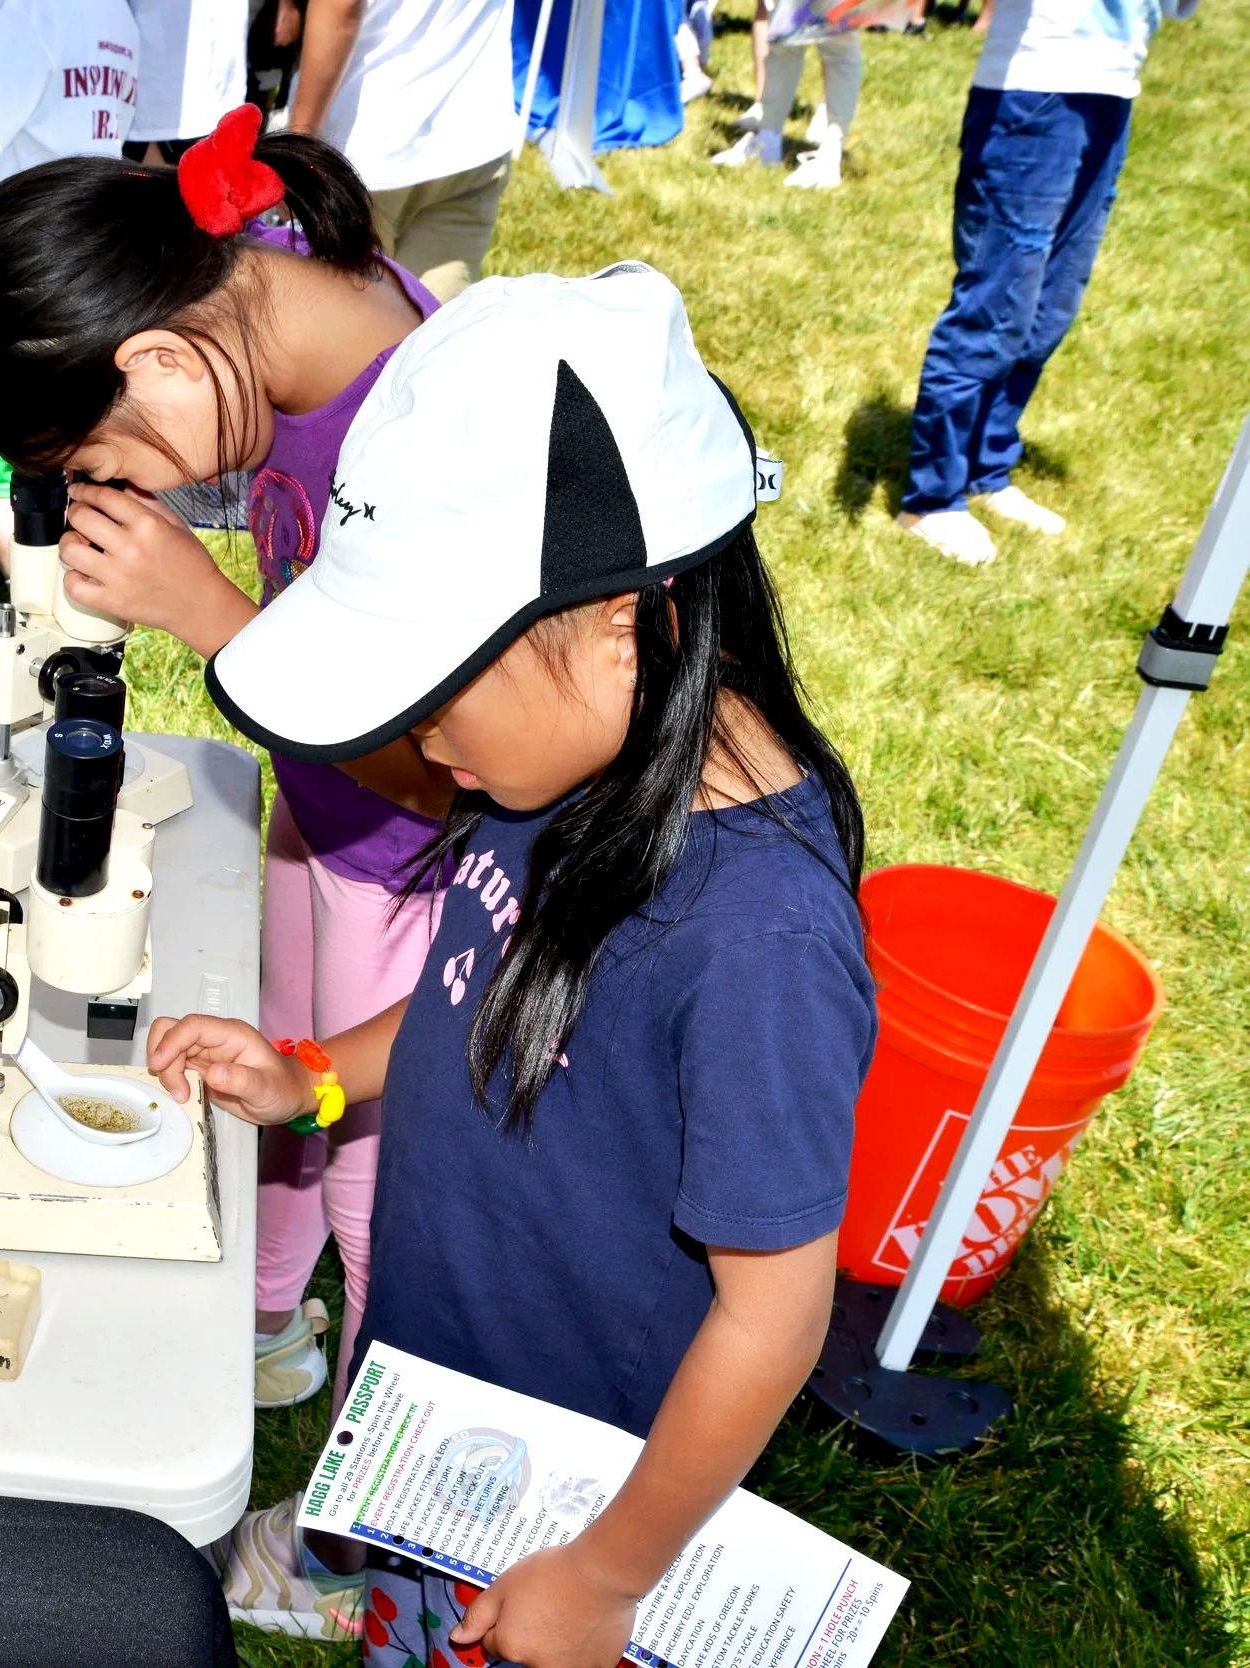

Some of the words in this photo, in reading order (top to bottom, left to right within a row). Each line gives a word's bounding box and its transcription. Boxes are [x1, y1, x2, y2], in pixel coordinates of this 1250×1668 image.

[453, 850, 521, 932] atur
[382, 1372, 400, 1398] Wheel
[376, 1399, 388, 1413] the
[304, 1481, 331, 1516] HAGG
[318, 1449, 345, 1480] LAKE
[345, 1360, 386, 1423] PASSPORT
[345, 1489, 357, 1502] for
[351, 1458, 372, 1489] PRIZES
[366, 1431, 385, 1458] before
[381, 1414, 393, 1431] you
[387, 1392, 404, 1414] leave
[348, 1436, 370, 1470] Stations
[343, 1470, 354, 1482] 29
[355, 1496, 373, 1522] EVENT
[368, 1439, 400, 1496] REGISTRATION
[395, 1412, 413, 1439] CHECK
[407, 1402, 418, 1413] IN
[369, 1501, 386, 1527] EVENT
[381, 1444, 414, 1501] REGISTRATION
[409, 1417, 427, 1444] CHECK
[422, 1399, 436, 1418] OUT
[472, 1461, 486, 1480] OUT
[339, 1481, 349, 1493] all
[393, 1453, 426, 1509] REGISTRATION
[432, 1464, 453, 1497] RETURN
[460, 1479, 478, 1507] CHECK
[473, 1475, 497, 1512] RETURNS
[327, 1503, 339, 1517] Go
[334, 1493, 344, 1503] to
[396, 1519, 410, 1537] LIFE
[405, 1491, 423, 1521] JACKET
[418, 1461, 438, 1492] FITTING
[419, 1496, 437, 1526] JACKET
[425, 1515, 445, 1547] ANGLER
[439, 1469, 467, 1515] EDUCATION
[488, 1484, 509, 1516] FISHING
[383, 1508, 398, 1531] BOAT
[410, 1524, 424, 1541] LIFE
[450, 1508, 466, 1527] REEL
[464, 1513, 480, 1532] REEL
[490, 1503, 516, 1546] BOARDING
[524, 1506, 547, 1544] ECOLOGY
[380, 1531, 389, 1539] 2
[407, 1541, 416, 1549] 3
[438, 1533, 452, 1552] ROD
[451, 1538, 466, 1558] ROD
[466, 1515, 494, 1562] SHORE-LINE
[493, 1555, 508, 1576] FISH
[503, 1516, 527, 1555] CLEANING
[435, 1552, 444, 1560] 5
[449, 1557, 458, 1566] 5
[462, 1563, 472, 1571] 6
[479, 1545, 495, 1569] BOAT
[476, 1569, 485, 1577] 7
[647, 1638, 659, 1652] BB
[654, 1618, 668, 1639] GUN
[663, 1600, 678, 1620] EDU.
[673, 1543, 706, 1600] EXPLORATION
[662, 1619, 685, 1659] ARCHERY
[690, 1543, 724, 1601] EXPLORATION
[823, 1611, 842, 1638] HOLE
[835, 1578, 858, 1613] PUNCH
[845, 1626, 858, 1643] 20+
[858, 1605, 870, 1617] 10
[864, 1581, 883, 1607] Spins
[626, 1643, 639, 1656] 18
[633, 1608, 655, 1643] GASTON
[650, 1589, 665, 1609] FIRE
[659, 1583, 668, 1591] &
[701, 1632, 717, 1653] KIDS
[711, 1619, 722, 1633] OF
[717, 1584, 740, 1620] OREGON
[722, 1615, 744, 1646] TACKLE
[738, 1583, 760, 1615] WORKS
[751, 1617, 780, 1666] EDUCATION
[775, 1586, 795, 1619] SAFETY
[676, 1618, 705, 1667] DAYCATION
[736, 1624, 758, 1656] TACKLE
[768, 1625, 796, 1668] XPERIENCE
[819, 1648, 837, 1668] HEEL
[830, 1627, 846, 1648] FOR
[840, 1597, 862, 1628] PRIZES
